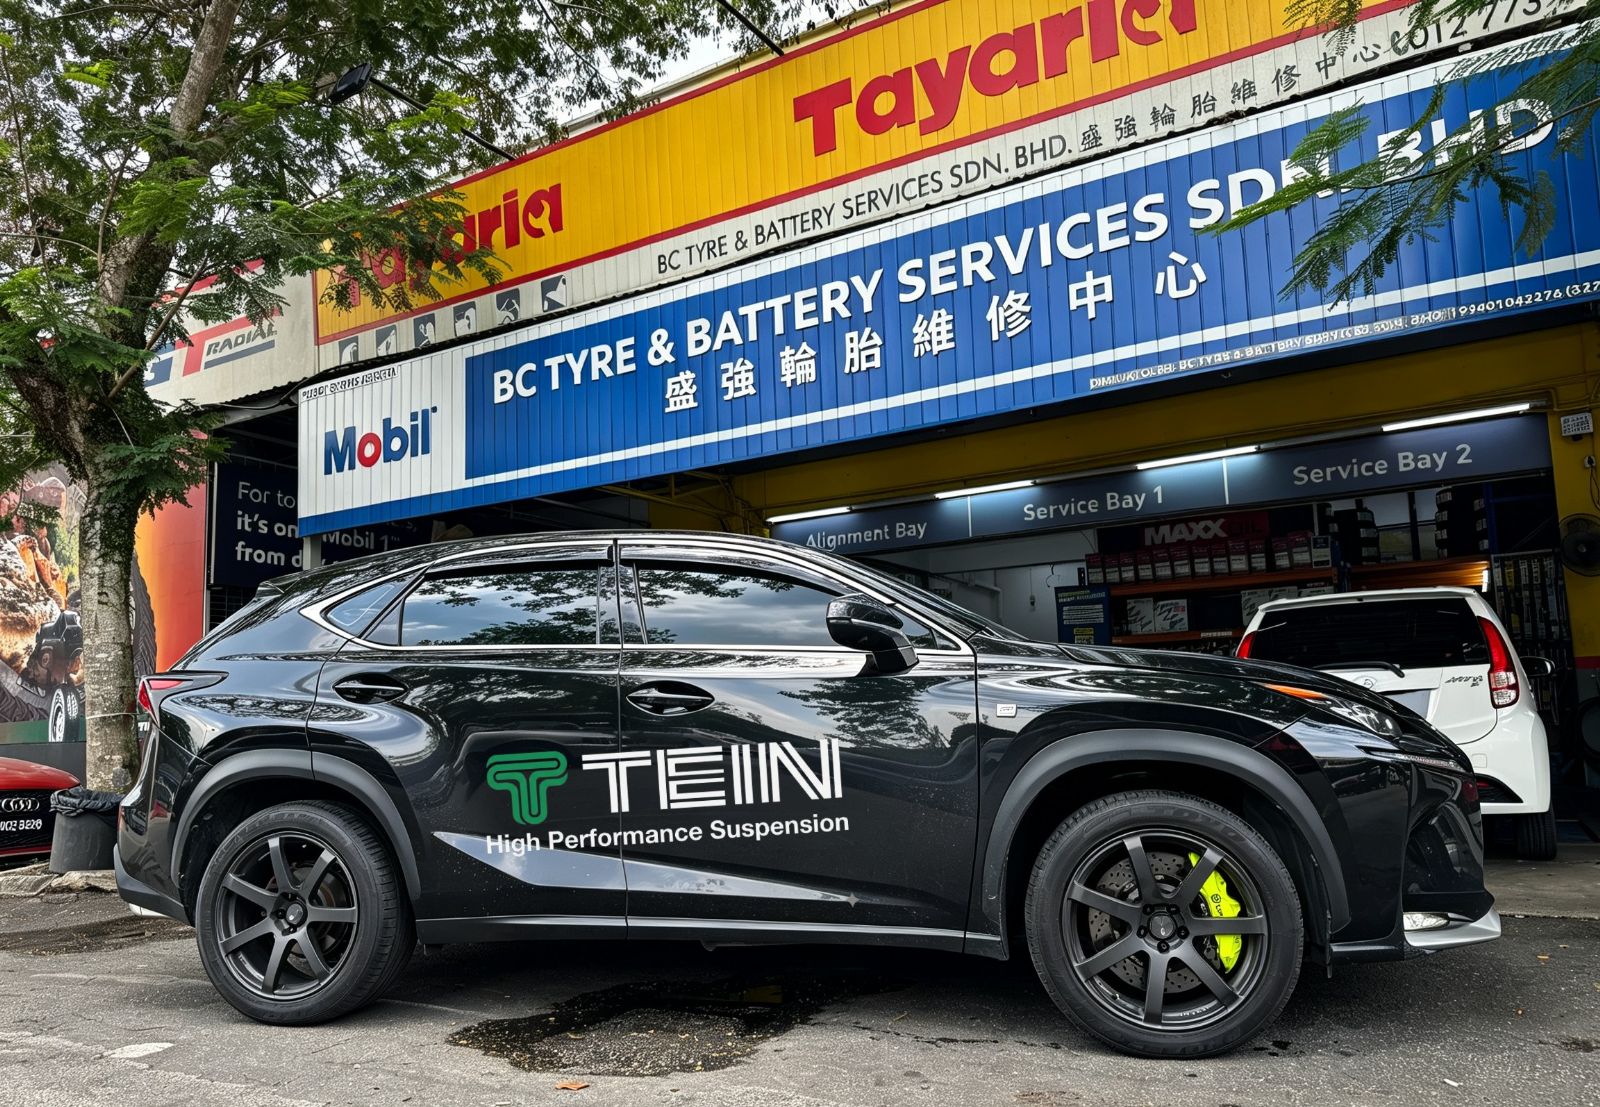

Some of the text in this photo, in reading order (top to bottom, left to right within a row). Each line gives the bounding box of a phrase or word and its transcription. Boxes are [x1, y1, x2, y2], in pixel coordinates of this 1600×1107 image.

[793, 0, 1197, 157] Tayaria
[657, 134, 1072, 275] BC TYRE & BATTERY SERVICES SDN. BHD.
[493, 362, 537, 405] BC
[544, 336, 637, 392] TYRE
[647, 327, 676, 367] &
[686, 268, 885, 358] BATTERY
[897, 193, 1169, 304] SERVICES
[664, 251, 1207, 413] 盛強輪胎維修中心
[324, 408, 430, 476] Mobil
[1292, 443, 1473, 487] Service Bay 2
[237, 481, 271, 503] For
[1023, 485, 1164, 522] Service Bay 1
[236, 510, 269, 534] it's
[322, 528, 375, 551] Mobil
[805, 521, 928, 552] Alignment Bay
[1144, 518, 1229, 546] MAXX
[235, 540, 285, 567] from
[582, 738, 844, 814] TEIN
[486, 814, 850, 857] High Performance Suspension
